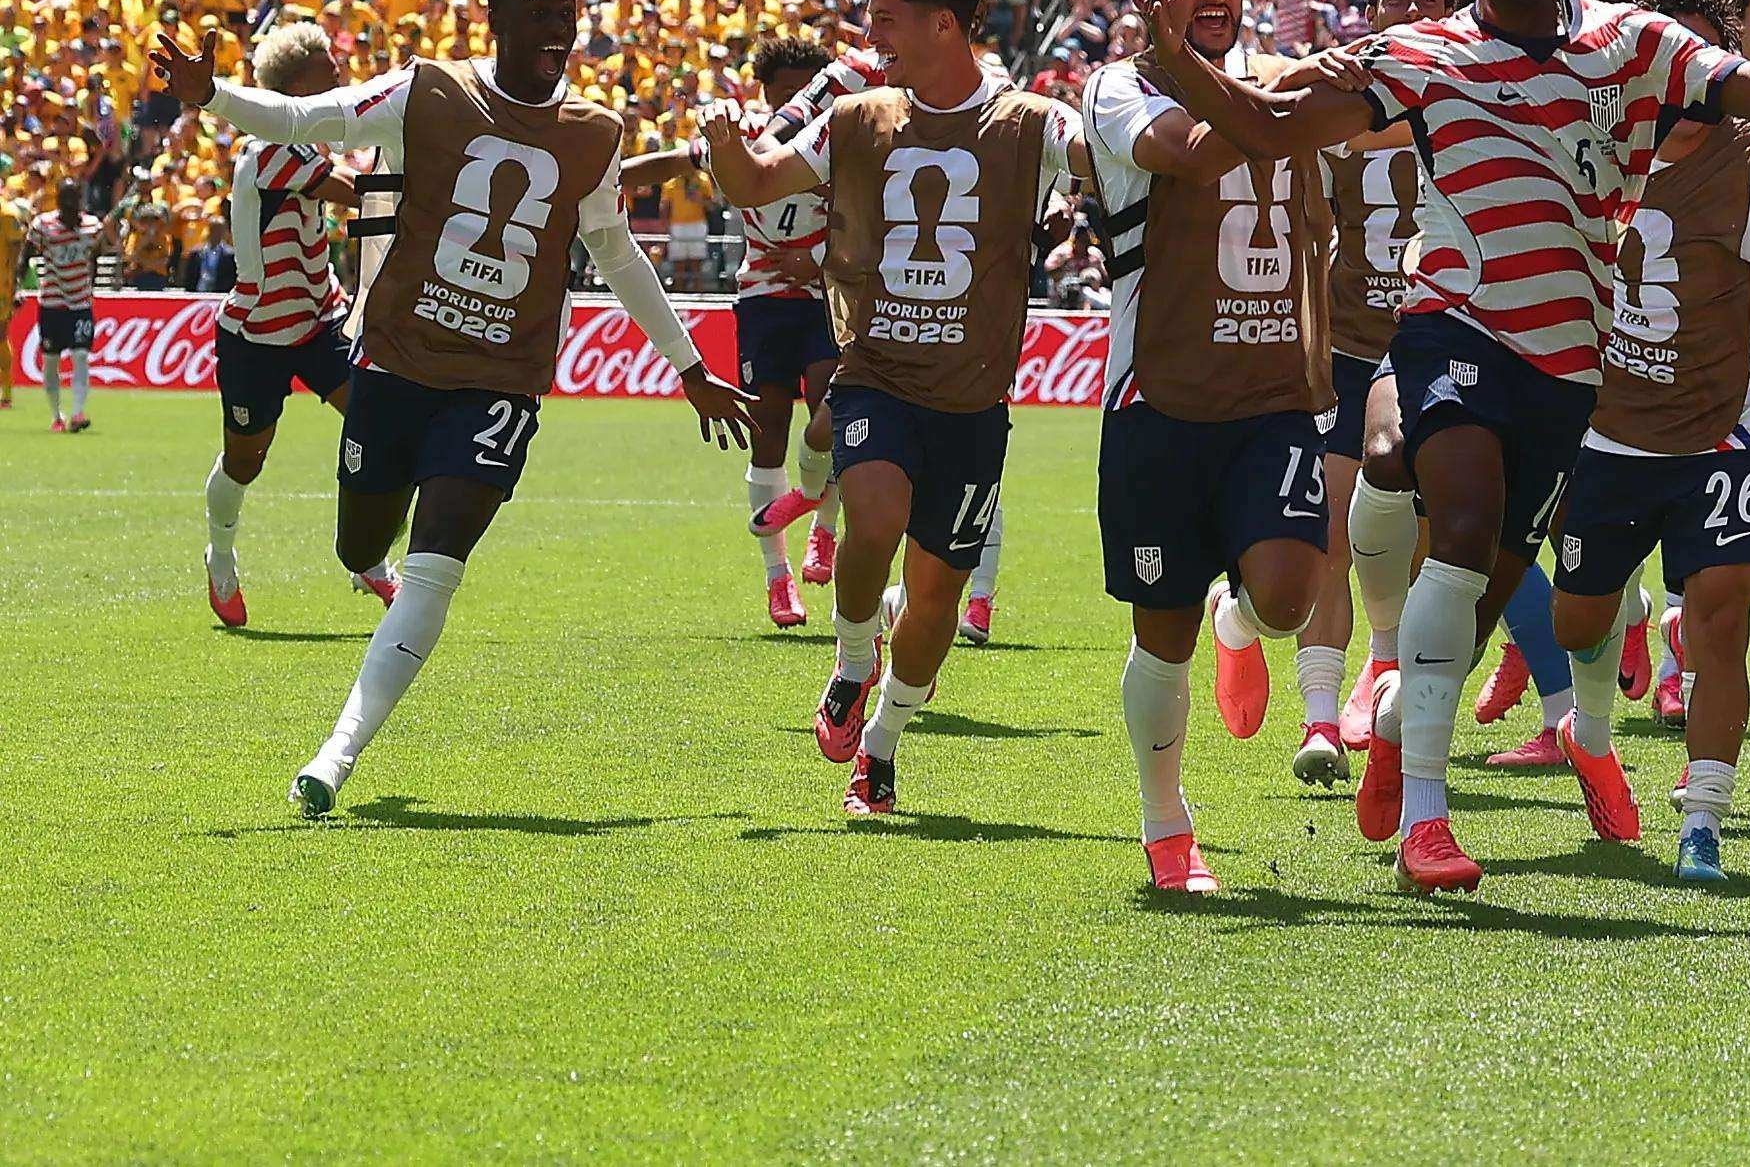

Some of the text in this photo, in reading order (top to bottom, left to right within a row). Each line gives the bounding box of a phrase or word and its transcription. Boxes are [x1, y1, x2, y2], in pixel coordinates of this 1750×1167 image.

[1591, 86, 1618, 108] USA
[777, 202, 797, 236] 4
[459, 258, 504, 285] FIFA
[903, 268, 948, 286] FIFA
[1246, 257, 1280, 276] FIFA
[1364, 276, 1408, 288] WOR
[422, 280, 517, 322] WORLD CUP
[874, 298, 968, 320] WORLD CUP
[1215, 299, 1293, 316] WORLD CUP
[1366, 289, 1408, 309] 20
[413, 296, 512, 345] 2026
[868, 316, 966, 345] 2026
[1212, 317, 1299, 345] 2026
[1608, 333, 1679, 364] ORLD CUP
[1013, 317, 1108, 403] ola
[1450, 360, 1479, 374] USA
[1605, 345, 1676, 385] 026
[473, 399, 530, 457] 21
[847, 418, 868, 433] USA
[346, 438, 362, 457] USA
[951, 482, 999, 535] 14
[1564, 535, 1582, 552] USA
[1136, 547, 1161, 564] USA
